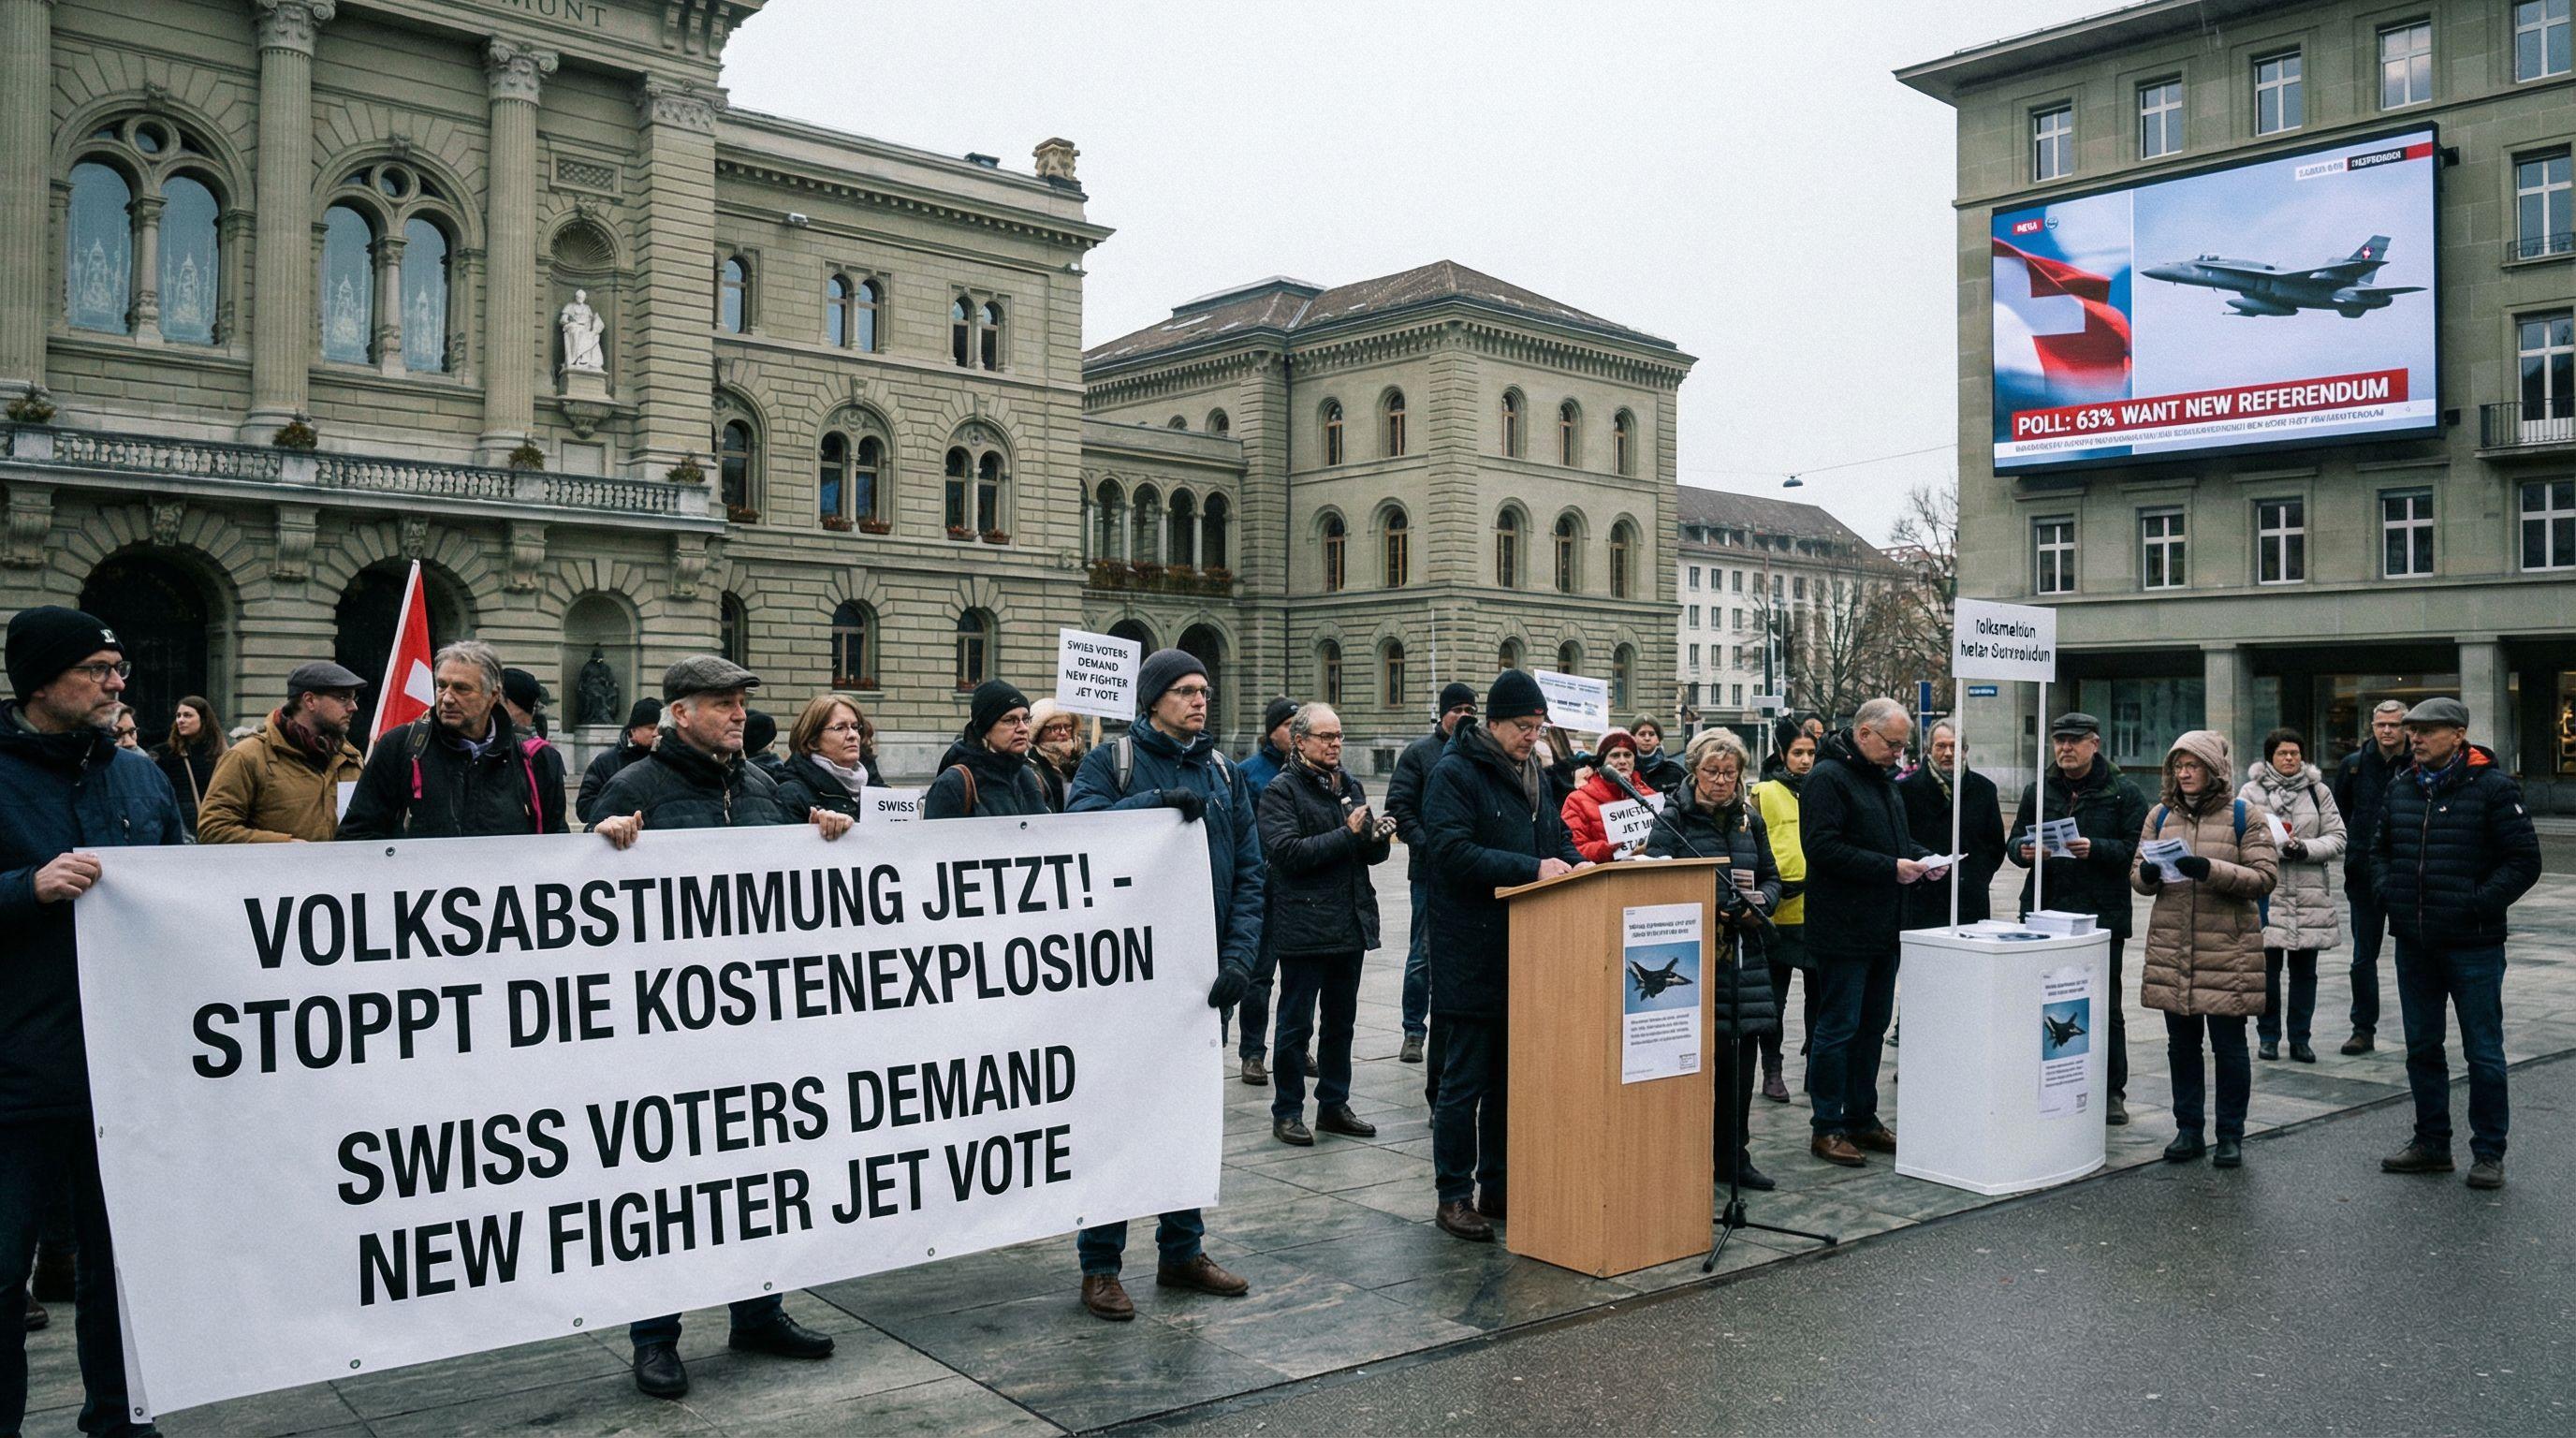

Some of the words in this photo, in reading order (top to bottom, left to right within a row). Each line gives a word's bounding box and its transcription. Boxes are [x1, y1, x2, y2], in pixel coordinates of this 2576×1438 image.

[2018, 414, 2071, 435] POLL:
[2076, 408, 2115, 430] 63%
[2121, 401, 2180, 425] WANT
[2185, 394, 2232, 418] NEW
[2238, 376, 2389, 413] REFERENDUM
[1065, 669, 1088, 682] NEW
[1090, 674, 1128, 688] FIGHTER
[1077, 657, 1119, 671] DEMAND
[1076, 687, 1091, 697] JET
[1094, 689, 1119, 701] VOTE
[878, 800, 915, 812] SWISS
[243, 863, 904, 969] VOLKSABSTIMMUNG
[922, 853, 1094, 921] JETZT!
[192, 983, 483, 1078] STOPPT
[507, 973, 615, 1049] DIE
[635, 925, 1154, 1035] KOSTENEXPLOSION
[337, 1108, 569, 1206] SWISS
[586, 1076, 828, 1168] VOTERS
[847, 1044, 1076, 1134] DEMAND
[359, 1211, 523, 1307] NEW
[549, 1168, 813, 1275] FIGHTER
[831, 1149, 929, 1225] JET
[944, 1123, 1072, 1202] VOTE
